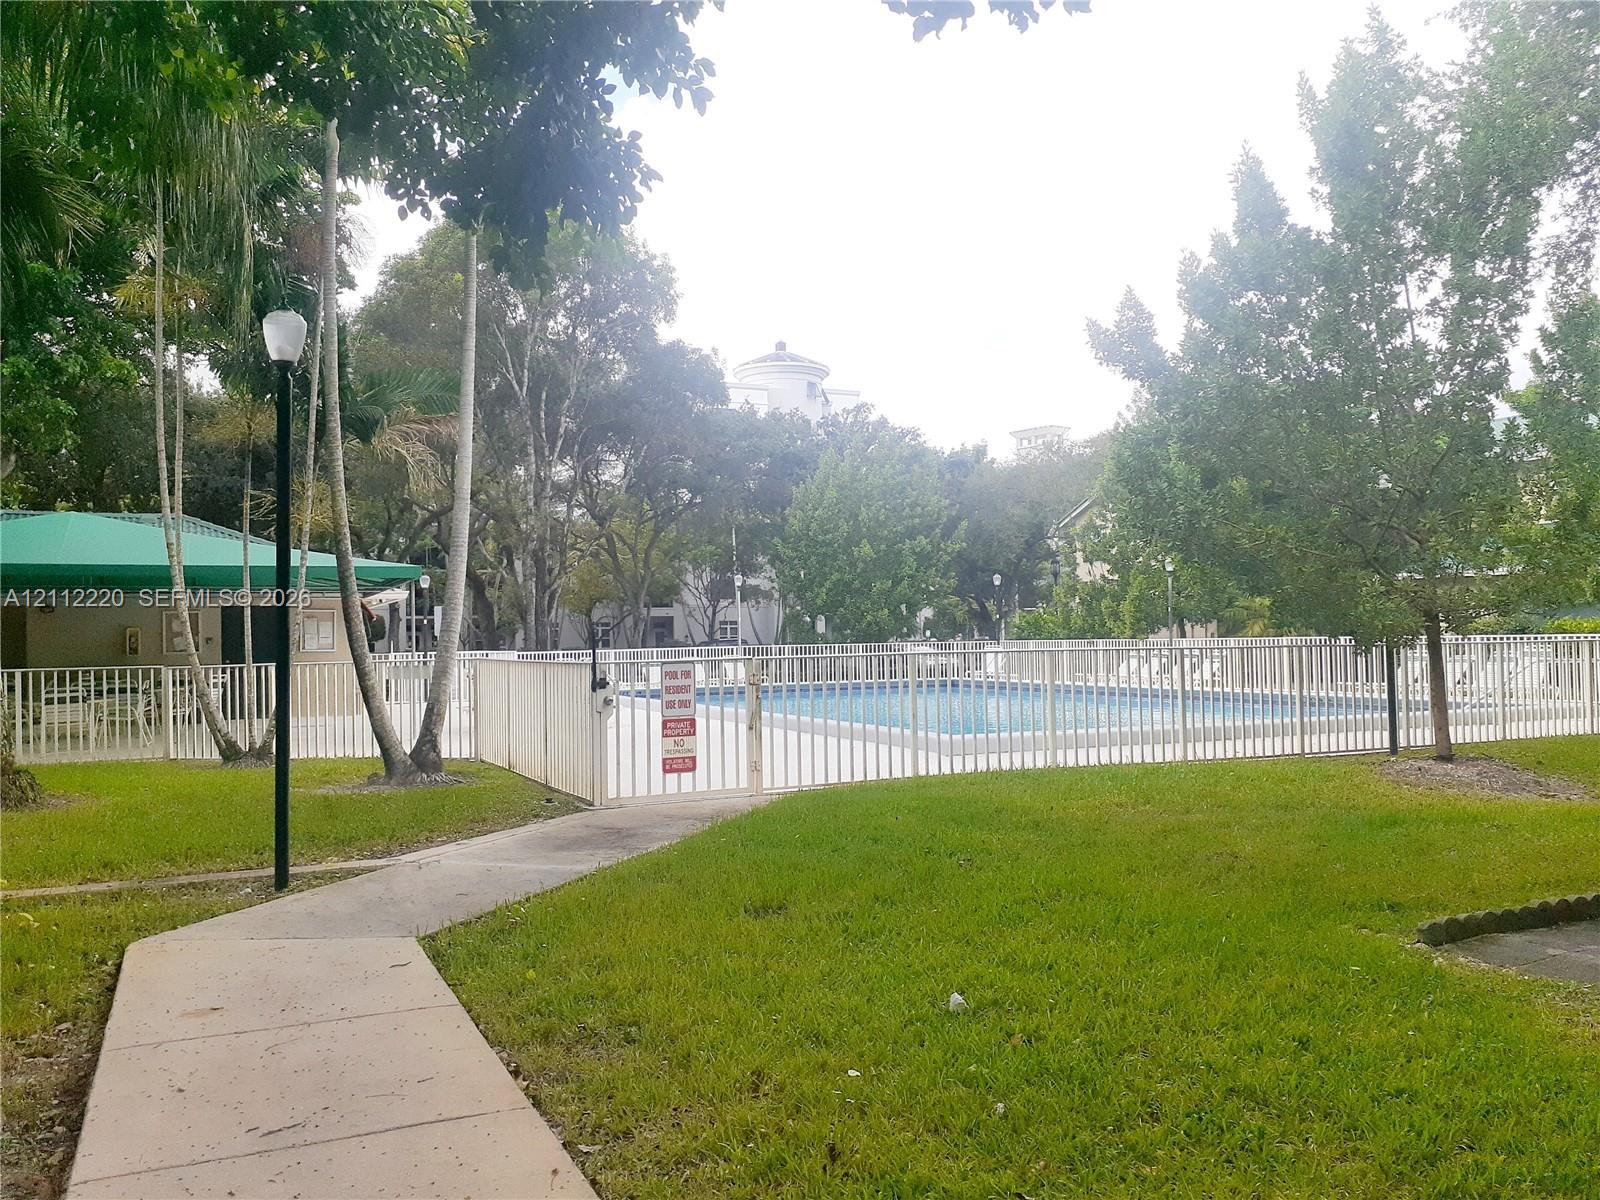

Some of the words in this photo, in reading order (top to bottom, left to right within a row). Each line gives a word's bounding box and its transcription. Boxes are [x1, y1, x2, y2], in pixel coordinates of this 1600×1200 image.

[665, 670, 679, 680] POOL
[681, 670, 692, 679] FOR
[665, 685, 691, 695] RESIDENT
[665, 699, 676, 710] USE
[678, 699, 691, 709] ONLY
[667, 721, 691, 729] PRIVATE
[664, 728, 694, 736] PROPERTY
[674, 738, 685, 748] NO
